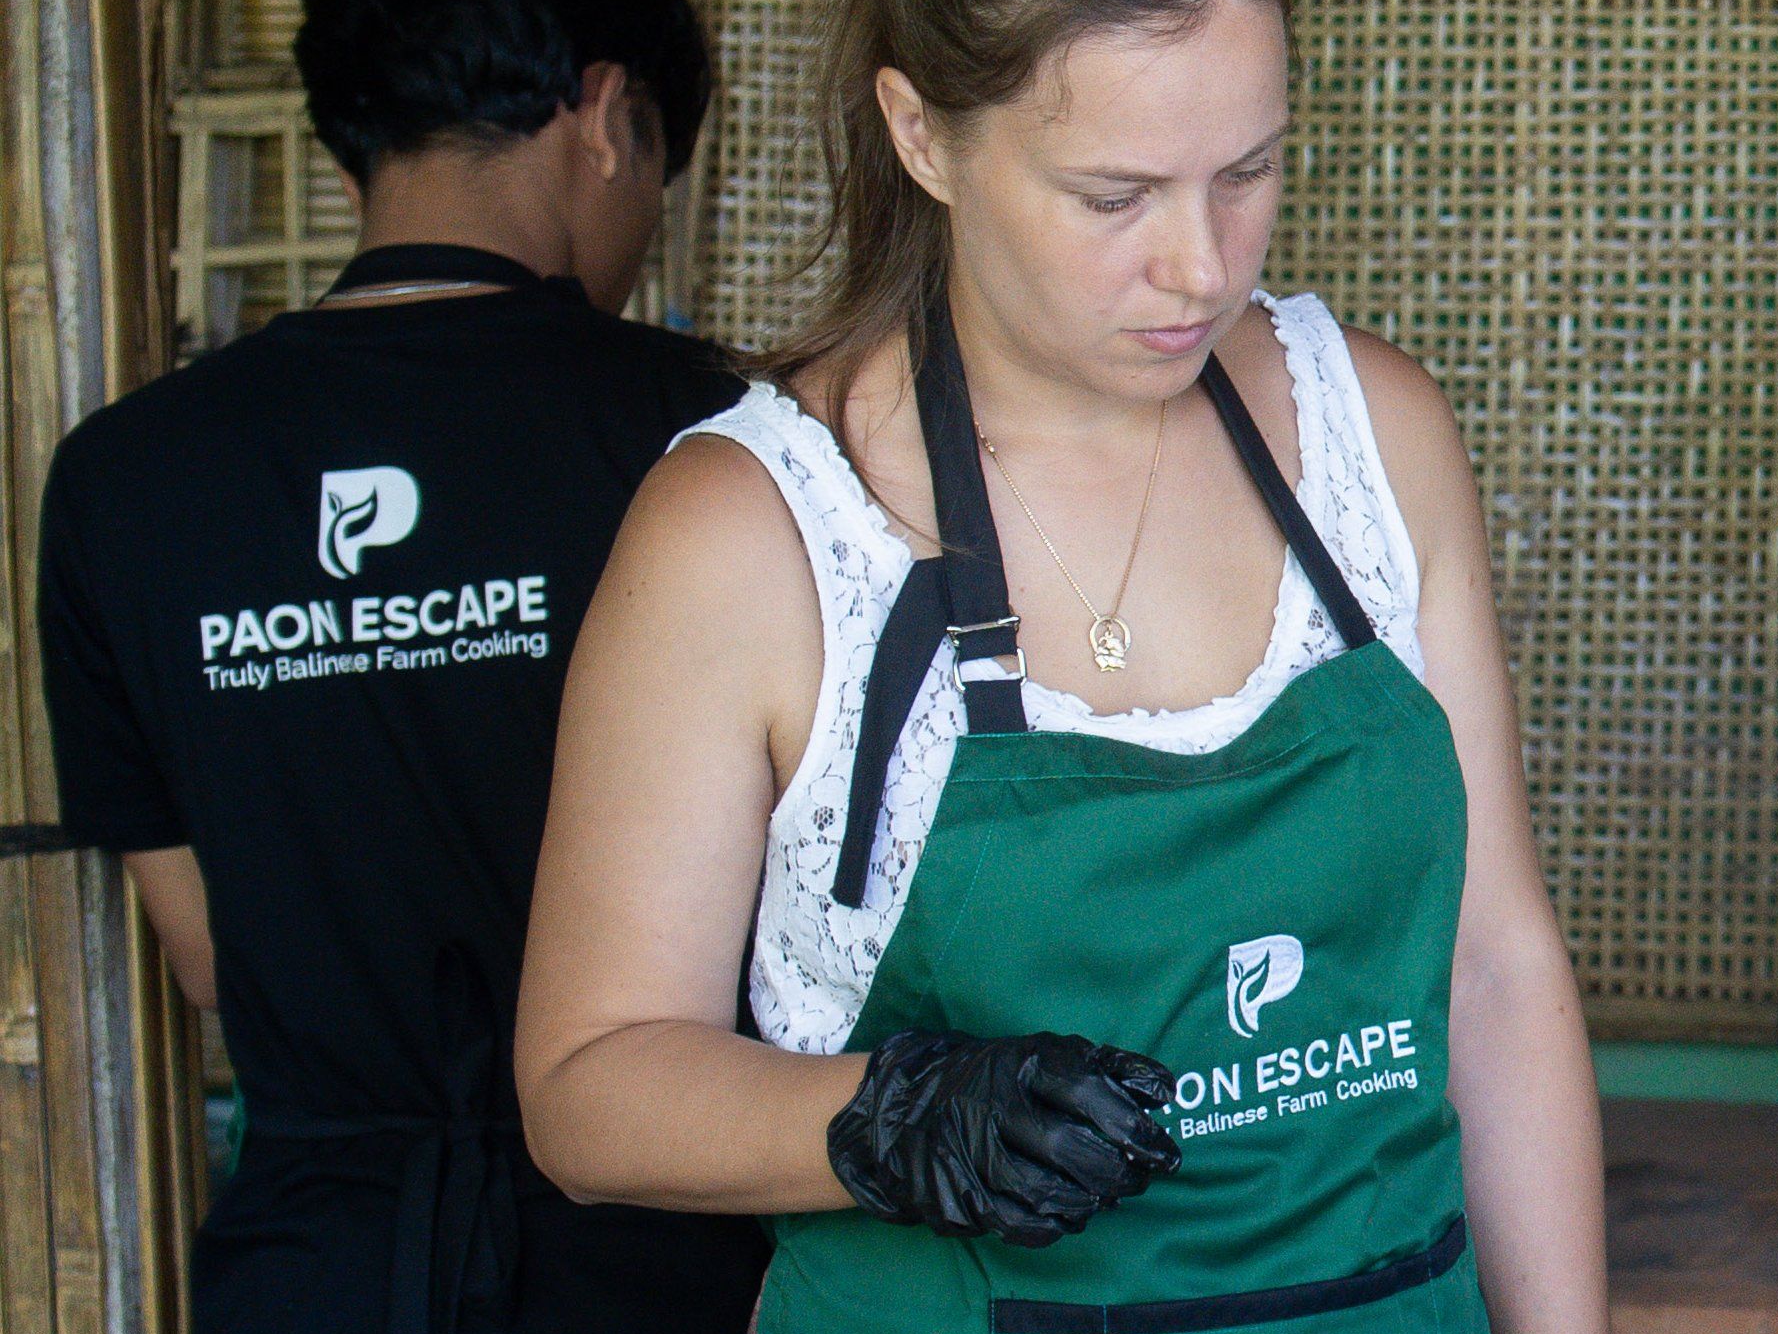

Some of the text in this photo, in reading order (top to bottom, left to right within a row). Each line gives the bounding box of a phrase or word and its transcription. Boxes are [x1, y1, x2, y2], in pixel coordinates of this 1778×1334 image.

[200, 575, 549, 661] PAON ESCAPE
[204, 629, 549, 691] Truly Balinee Farm Cooking
[1255, 1020, 1416, 1093] ESCAPE
[1180, 1067, 1419, 1140] Balinese Farm Cooking
